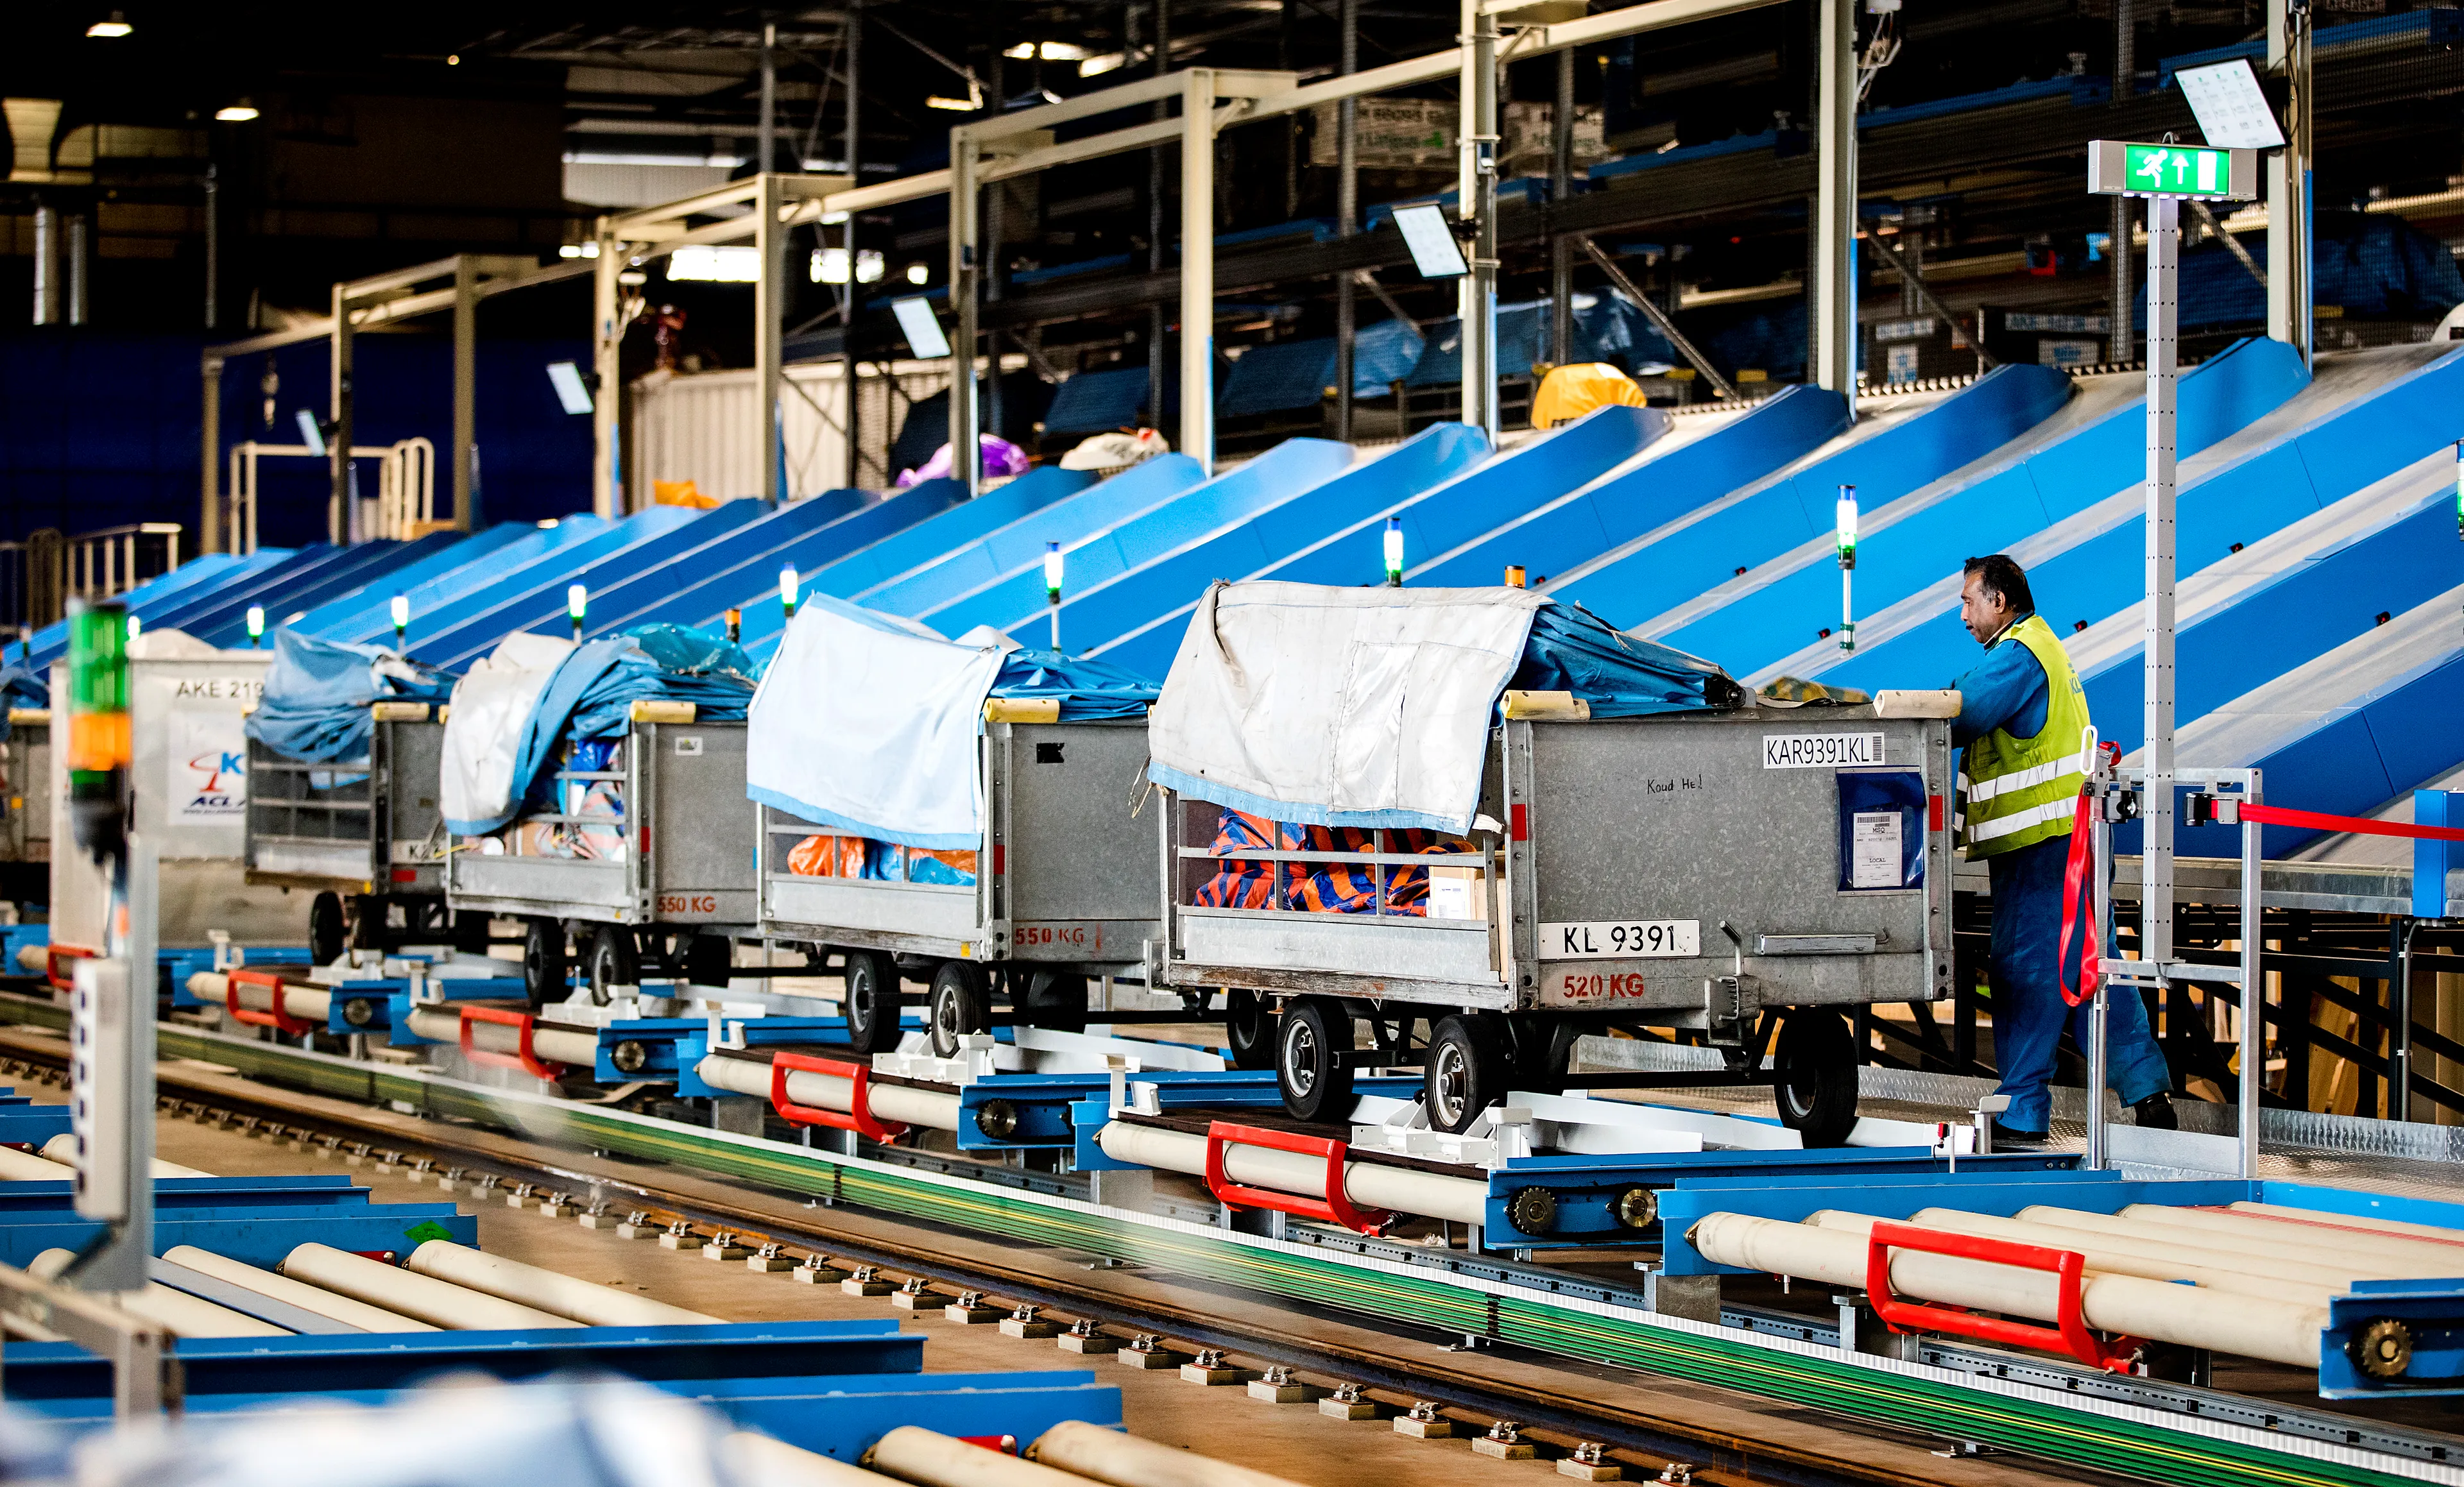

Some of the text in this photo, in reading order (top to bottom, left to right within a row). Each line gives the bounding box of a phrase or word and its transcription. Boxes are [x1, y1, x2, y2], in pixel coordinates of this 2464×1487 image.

[176, 681, 221, 698] AKE
[2069, 676, 2082, 694] KL
[1767, 738, 1870, 765] KAR9391KL
[1647, 779, 1673, 795] Koud
[657, 896, 716, 913] 550 KG
[1015, 928, 1084, 945] 550 KG
[1564, 925, 1675, 953] KL 9391
[1563, 973, 1645, 1000] 520 KG
